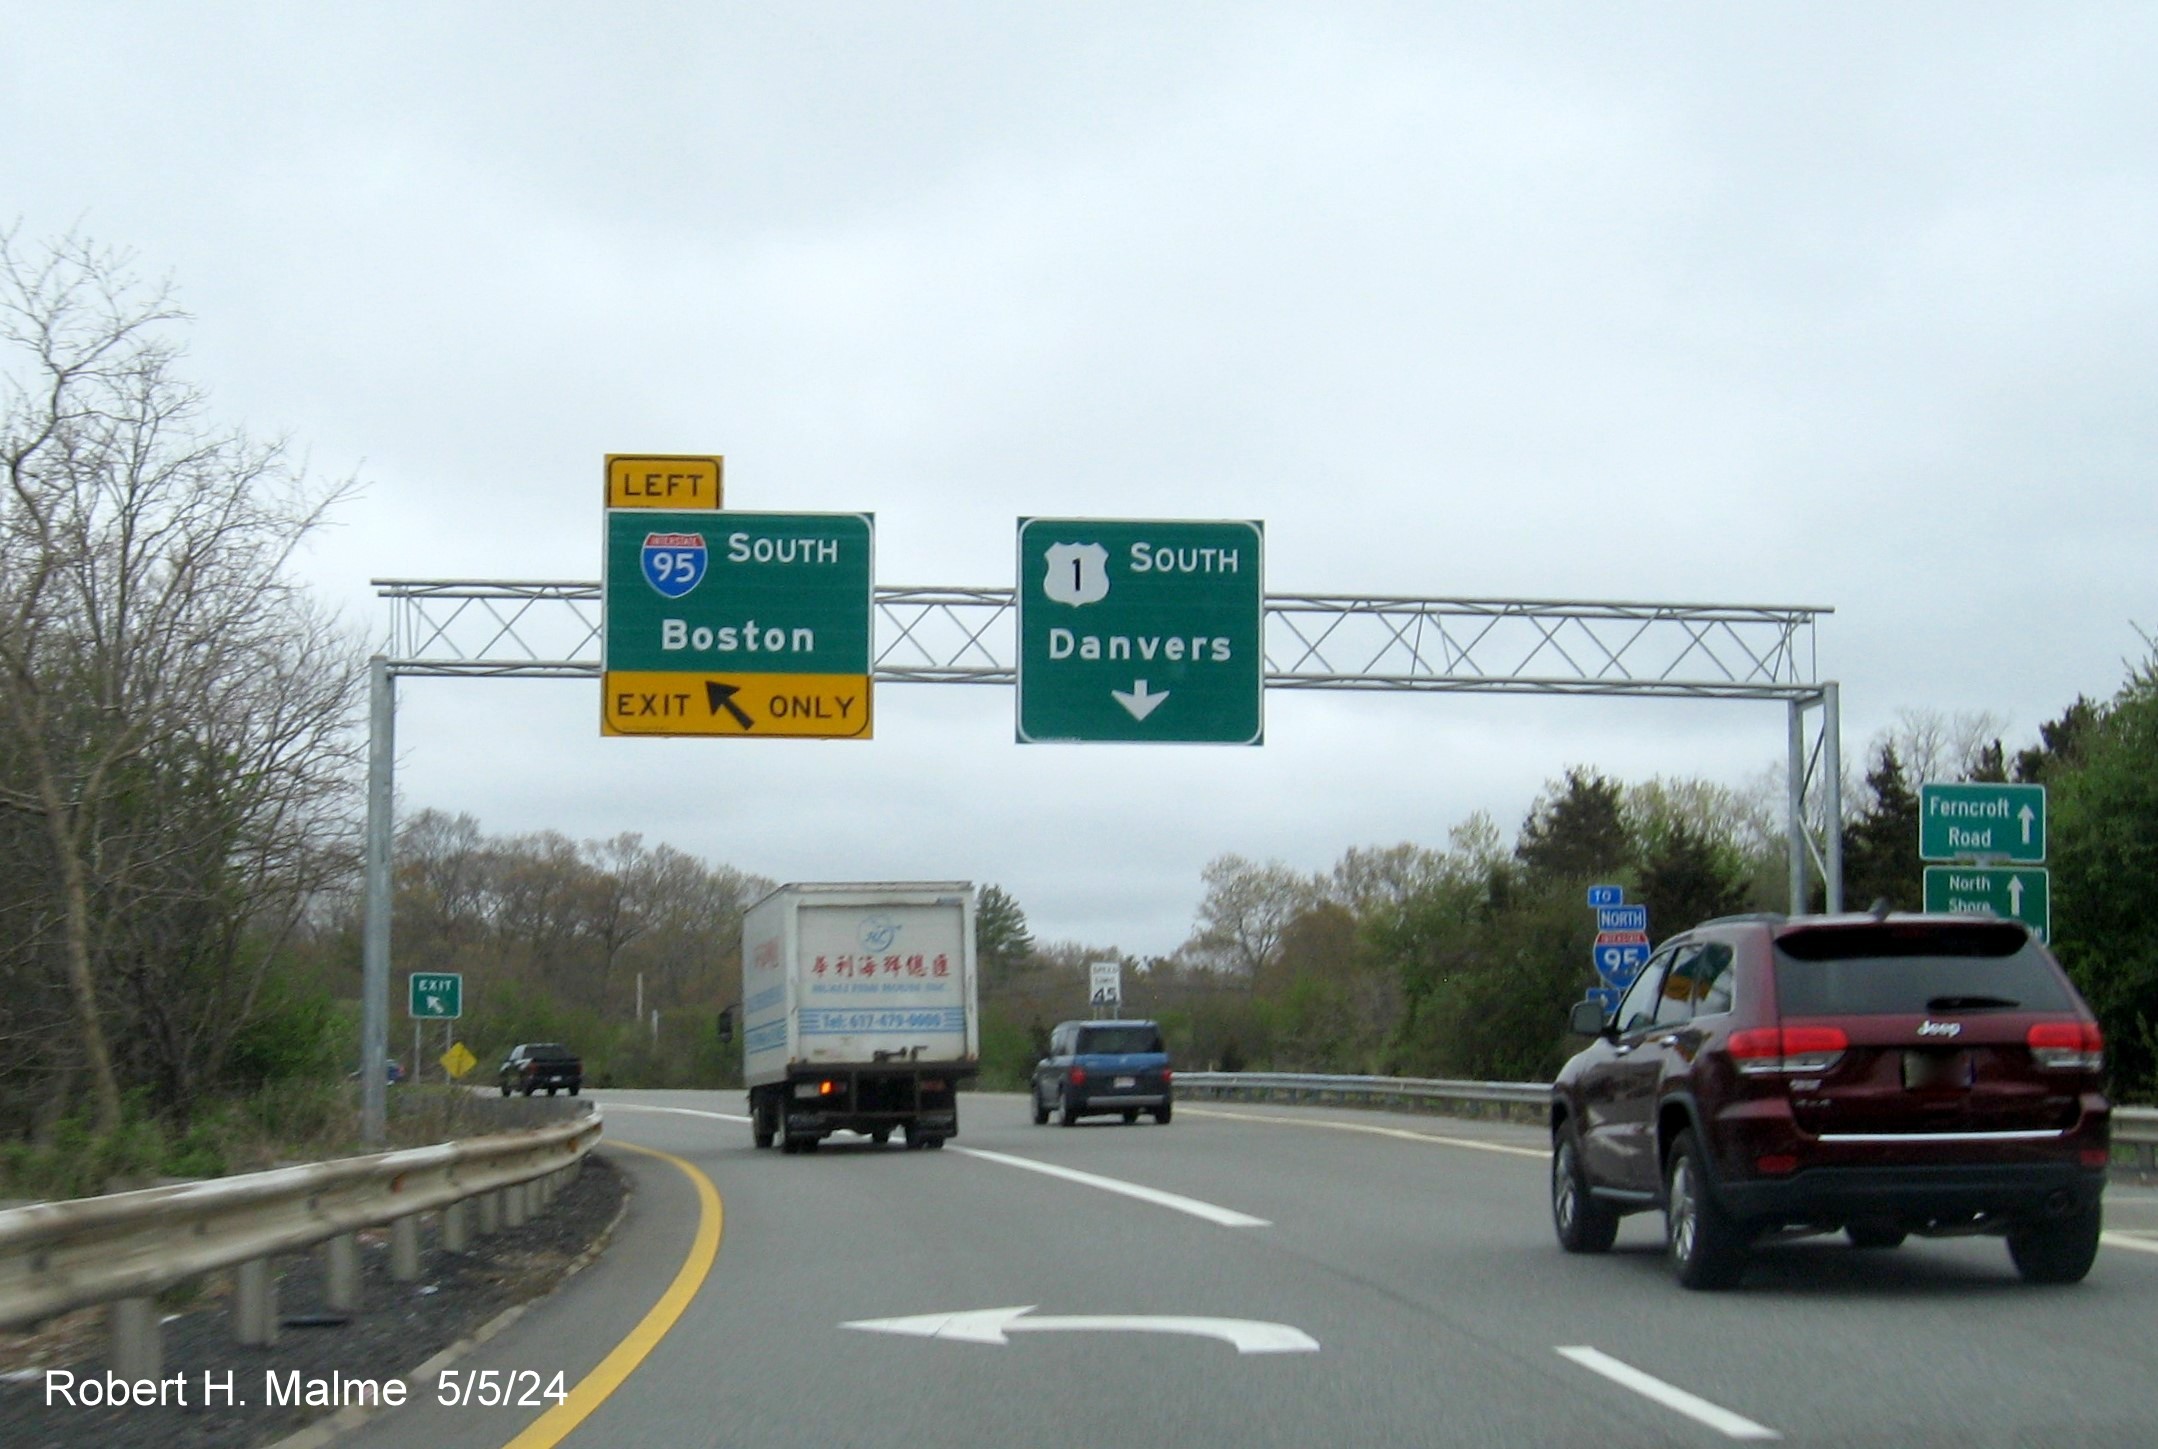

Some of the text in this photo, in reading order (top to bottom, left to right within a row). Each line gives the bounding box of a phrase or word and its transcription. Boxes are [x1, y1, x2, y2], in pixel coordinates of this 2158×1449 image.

[624, 473, 704, 497] LEFT
[727, 532, 838, 563] SOUTH
[1129, 541, 1239, 573] SOUTH
[653, 551, 696, 583] 95
[1071, 557, 1082, 592] 1
[661, 618, 815, 652] Boston
[1049, 627, 1232, 662] Danvers
[617, 693, 855, 719] EXIT ONLY
[1929, 795, 2010, 819] Ferncroft
[1948, 826, 1992, 848] Road
[1949, 874, 1991, 892] North
[1949, 898, 1991, 913] Shore
[1601, 909, 1642, 928] NORTH
[1604, 948, 1639, 973] 95
[418, 979, 453, 992] EXIT
[1917, 1019, 1961, 1039] Jeep
